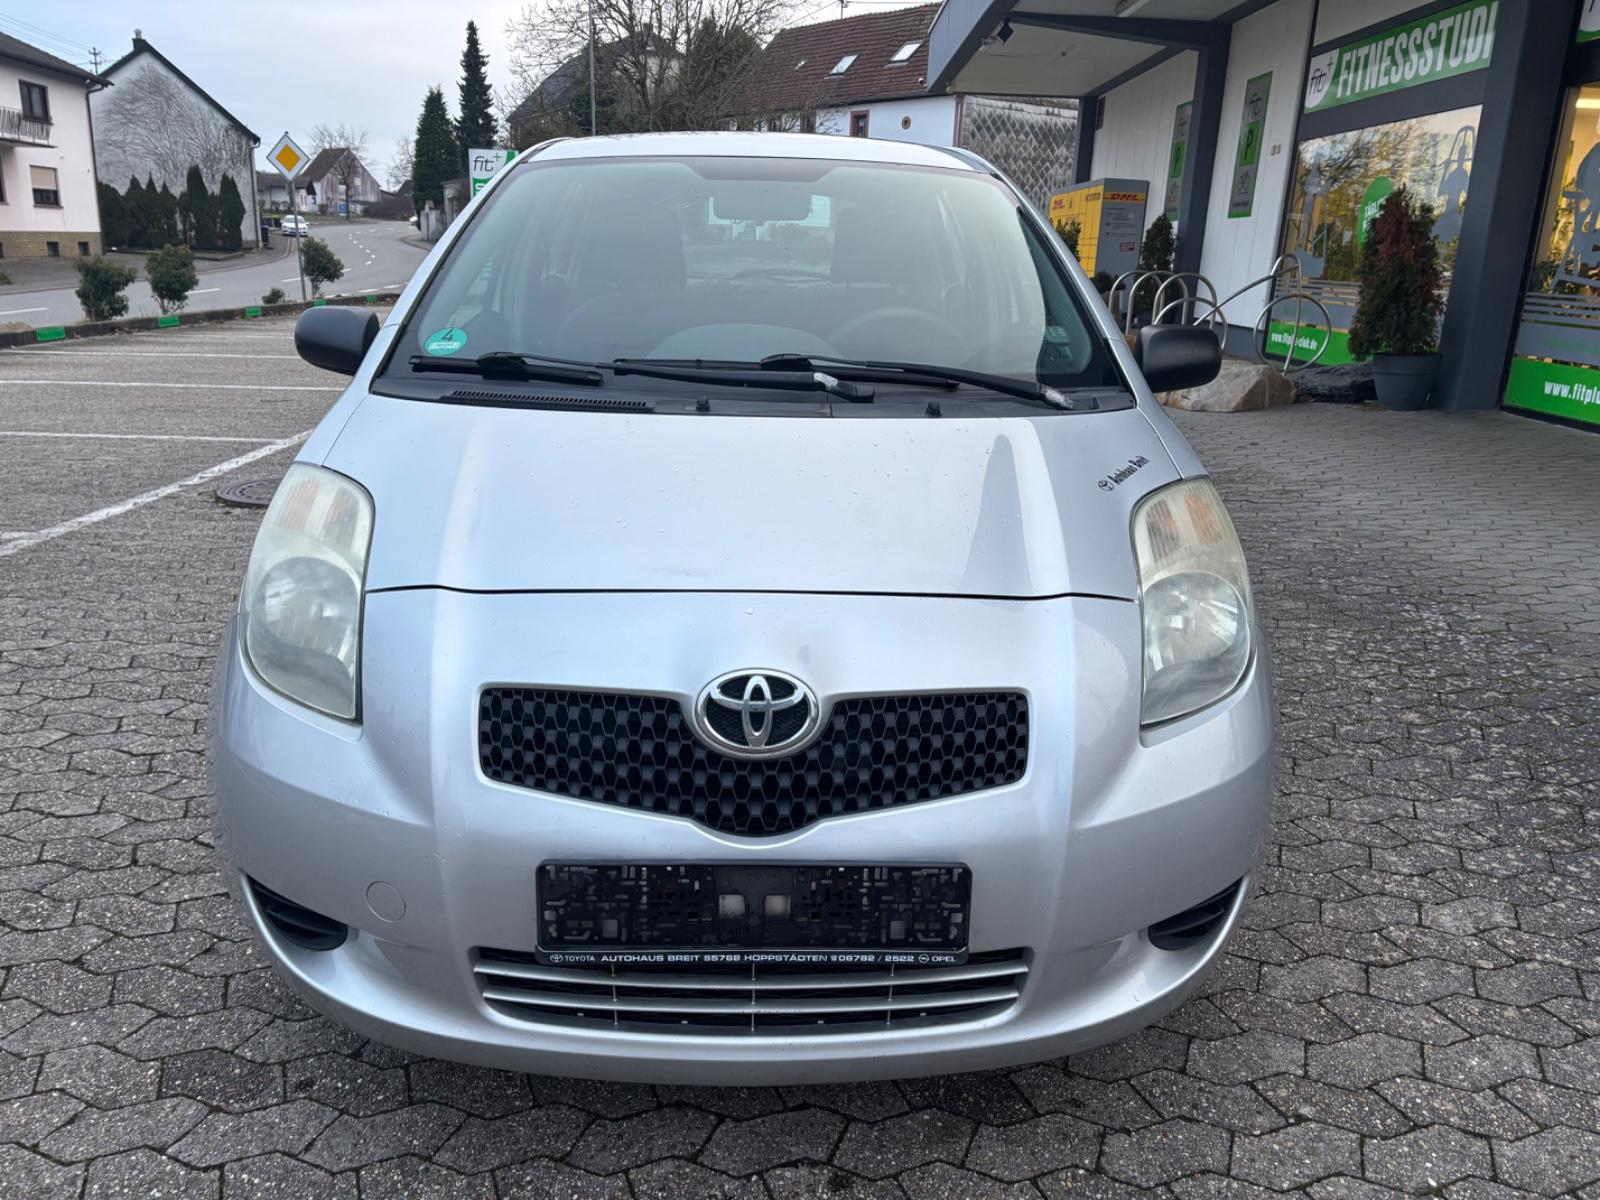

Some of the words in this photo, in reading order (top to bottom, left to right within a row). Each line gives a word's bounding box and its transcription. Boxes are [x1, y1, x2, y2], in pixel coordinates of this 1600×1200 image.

[1243, 128, 1255, 161] P
[441, 328, 455, 342] 4
[601, 954, 664, 962] AUTOHAUS
[668, 954, 700, 962] BREIT
[884, 954, 914, 962] 2522
